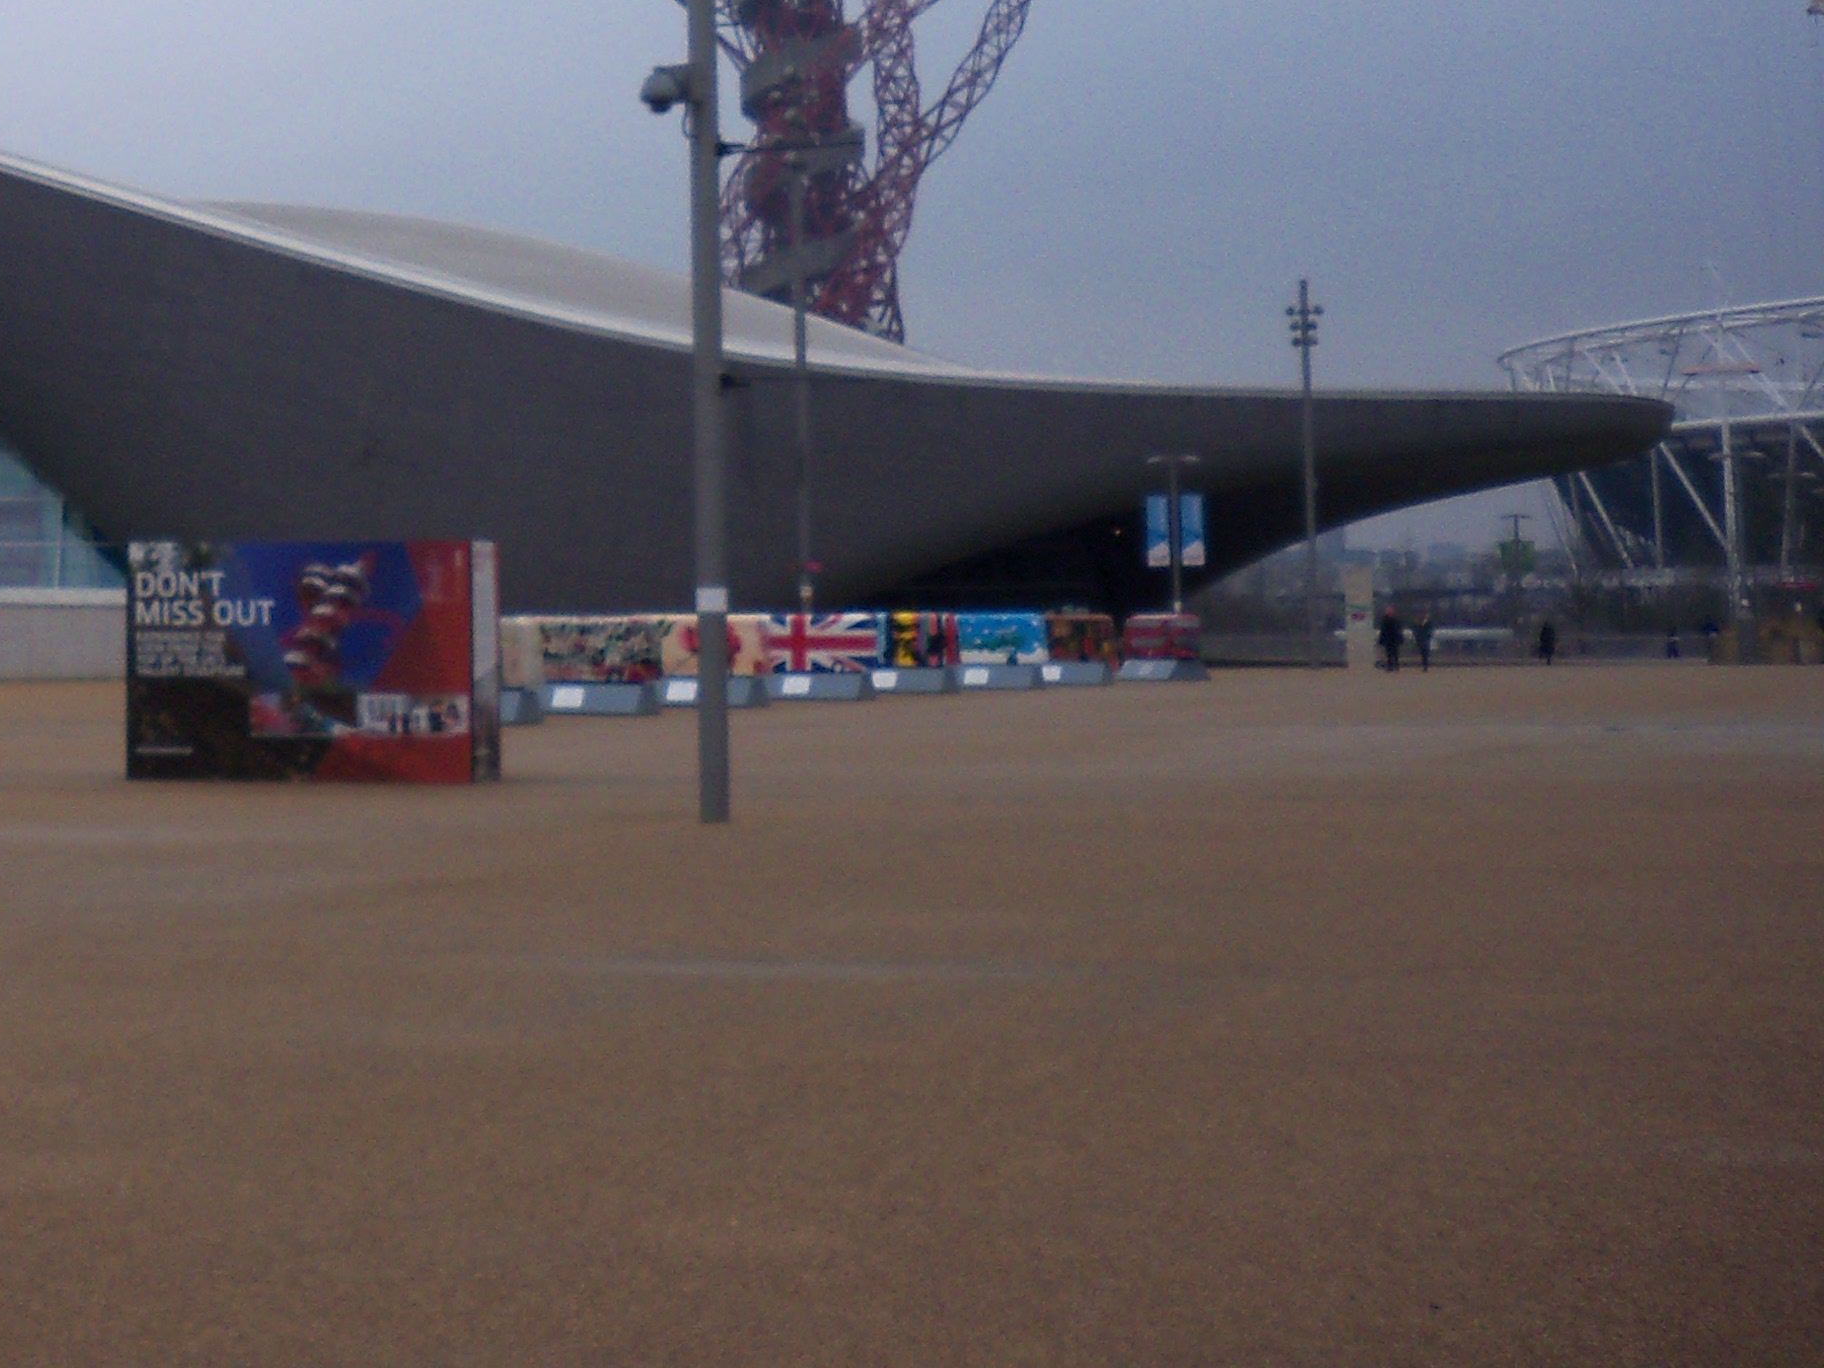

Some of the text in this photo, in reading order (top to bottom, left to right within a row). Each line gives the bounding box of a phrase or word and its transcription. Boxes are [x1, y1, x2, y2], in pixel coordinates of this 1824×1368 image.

[136, 571, 225, 597] DON'T
[136, 600, 275, 626] MISS OUT
